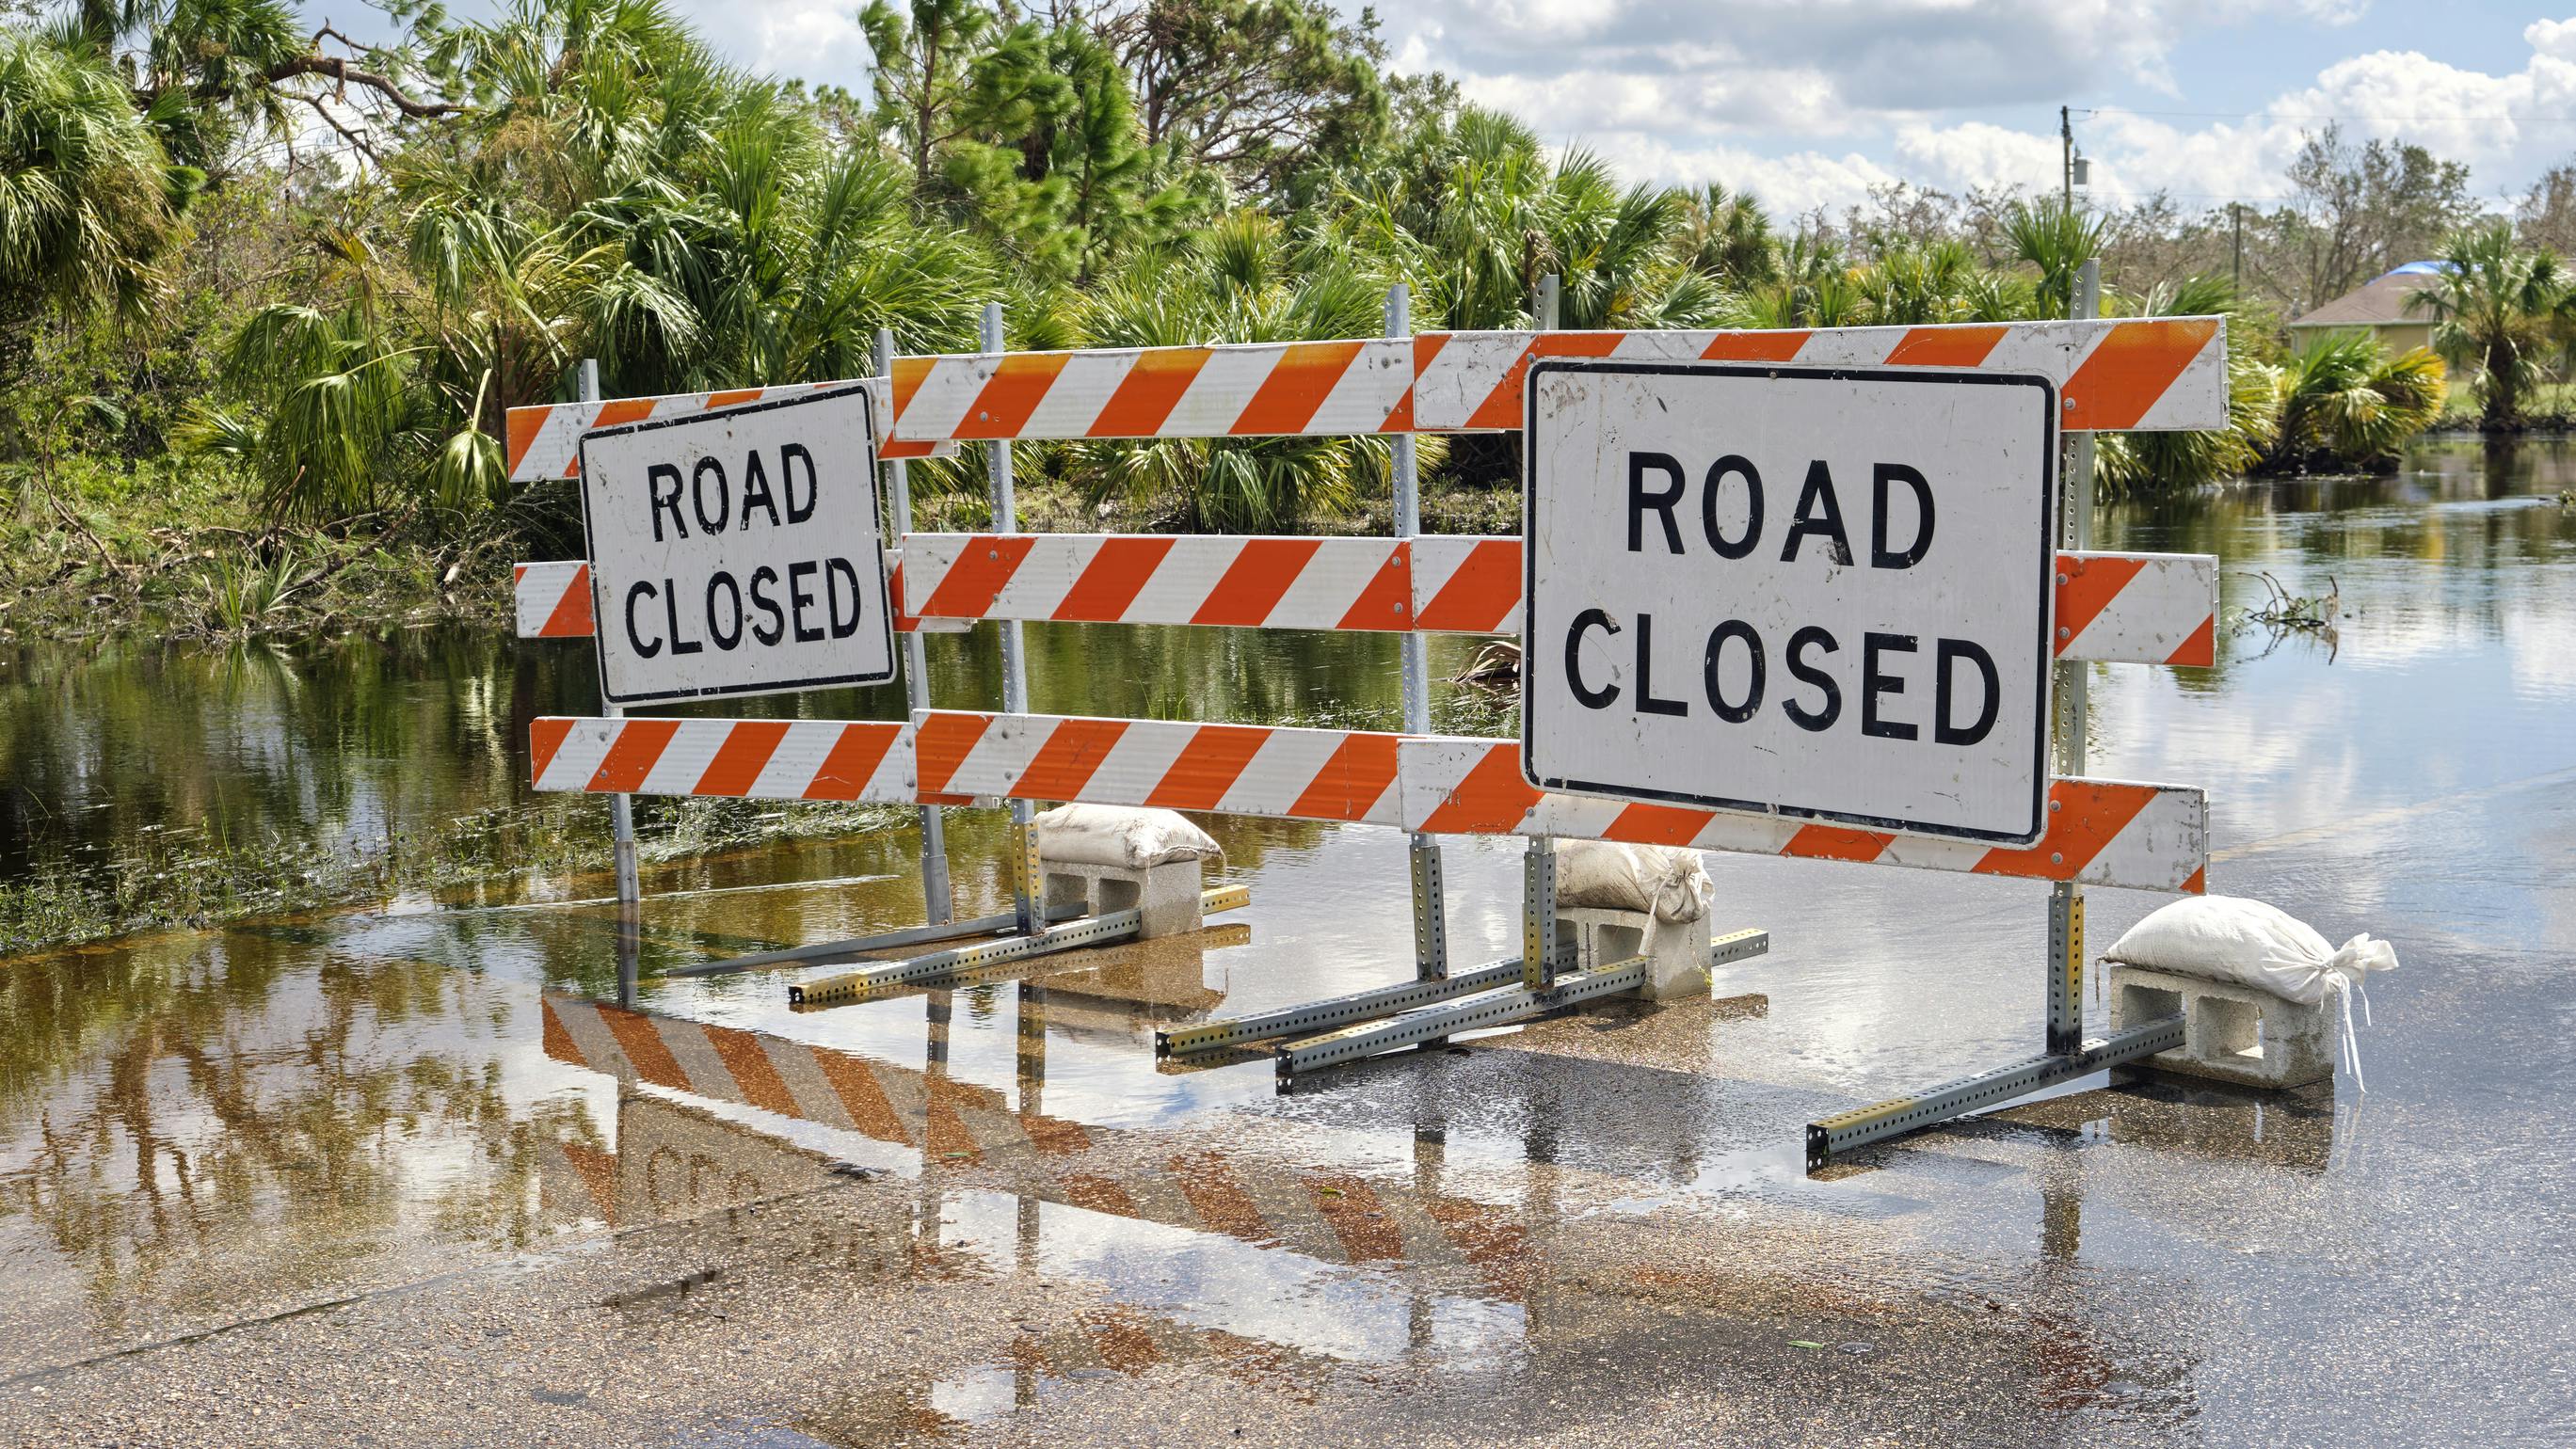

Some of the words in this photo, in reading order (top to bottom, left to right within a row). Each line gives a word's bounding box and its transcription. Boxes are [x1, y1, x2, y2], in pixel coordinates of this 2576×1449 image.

[648, 443, 817, 542] ROAD
[1627, 451, 1936, 570] ROAD
[626, 557, 861, 659] CLOSED
[1564, 608, 2001, 746] CLOSED
